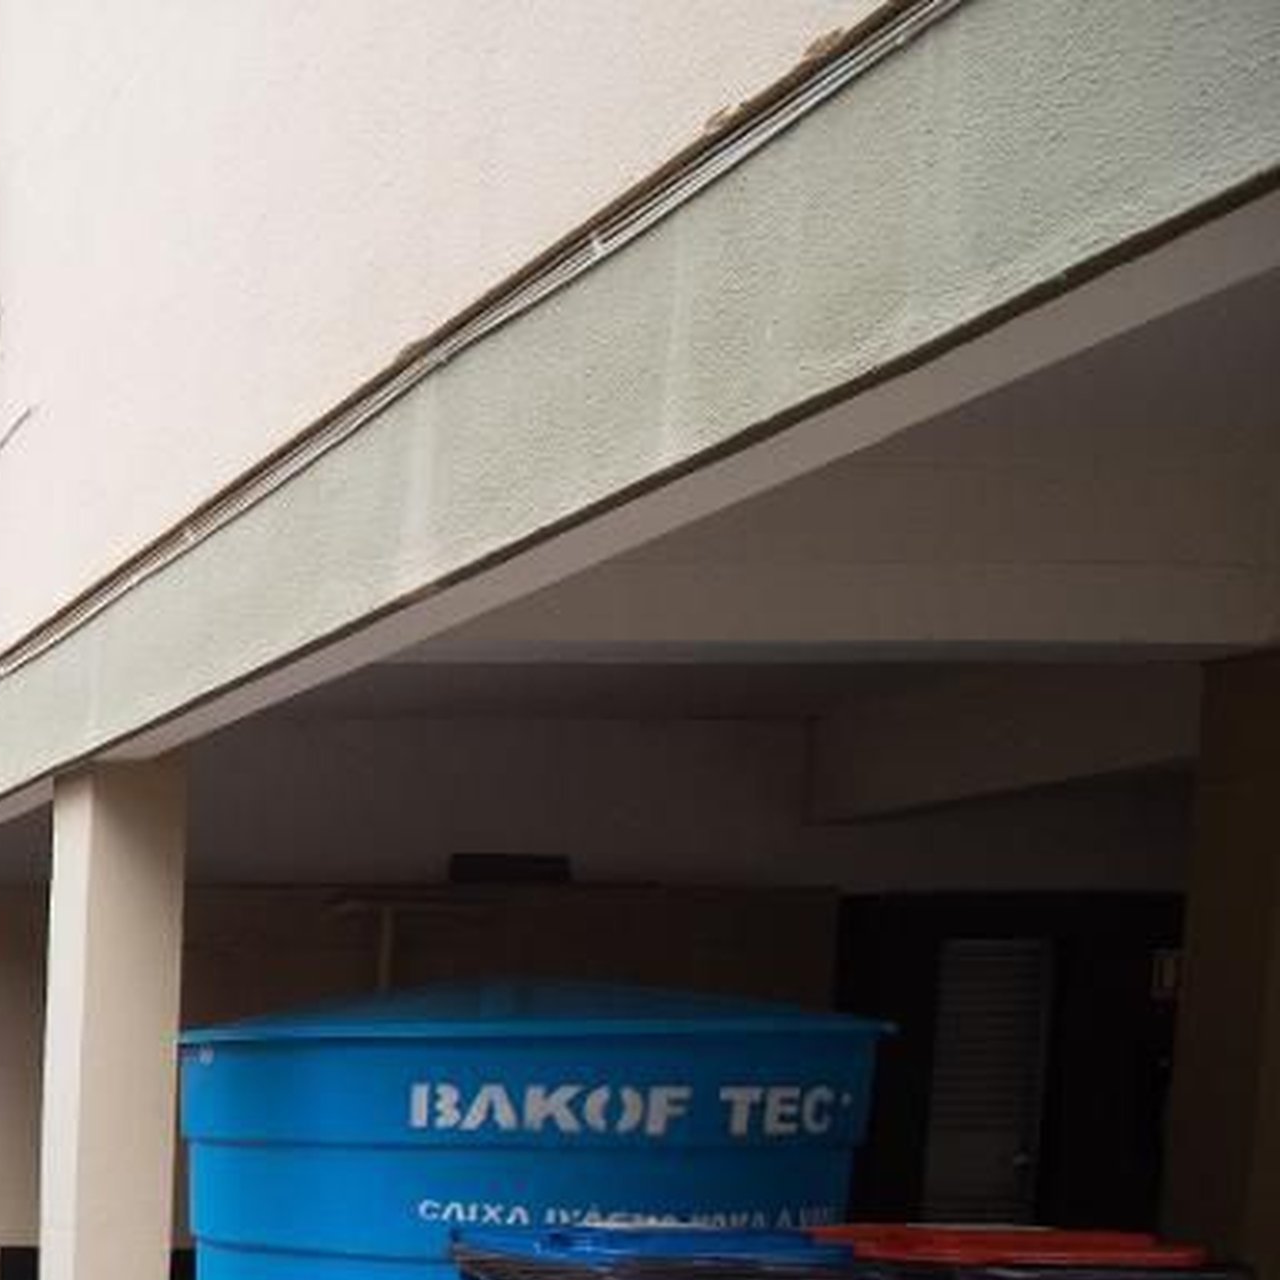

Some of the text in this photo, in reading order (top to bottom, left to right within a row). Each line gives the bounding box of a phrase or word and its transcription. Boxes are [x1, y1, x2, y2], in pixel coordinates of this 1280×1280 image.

[409, 1082, 836, 1136] BAKOF TEC
[418, 1199, 530, 1226] CAIXA
